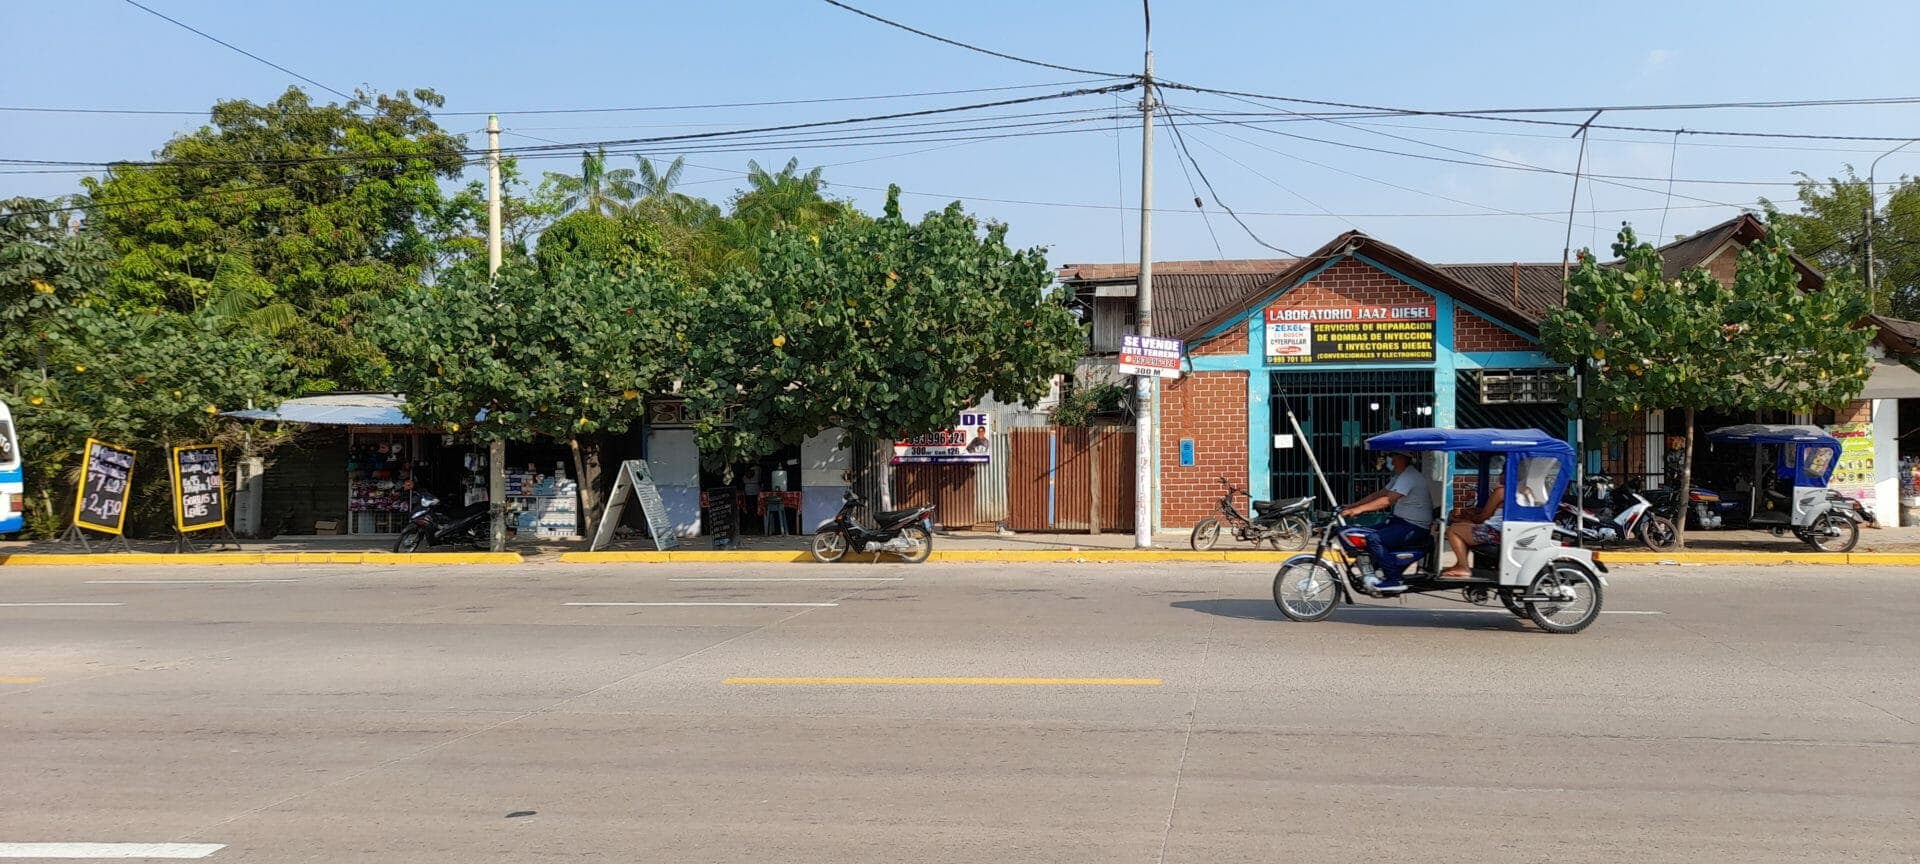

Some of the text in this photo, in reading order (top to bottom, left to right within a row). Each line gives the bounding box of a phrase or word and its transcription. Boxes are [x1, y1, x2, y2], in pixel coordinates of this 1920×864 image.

[1270, 307, 1431, 321] LABORATORIO JAAZ DIESEL
[1314, 324, 1360, 332] SERVICIOS
[1376, 322, 1432, 330] REPARACION
[1331, 333, 1369, 341] BOMBAS
[1384, 332, 1432, 340] INYECCION
[1124, 336, 1180, 351] SE VENDE
[1122, 347, 1180, 359] ESTE TERRENO
